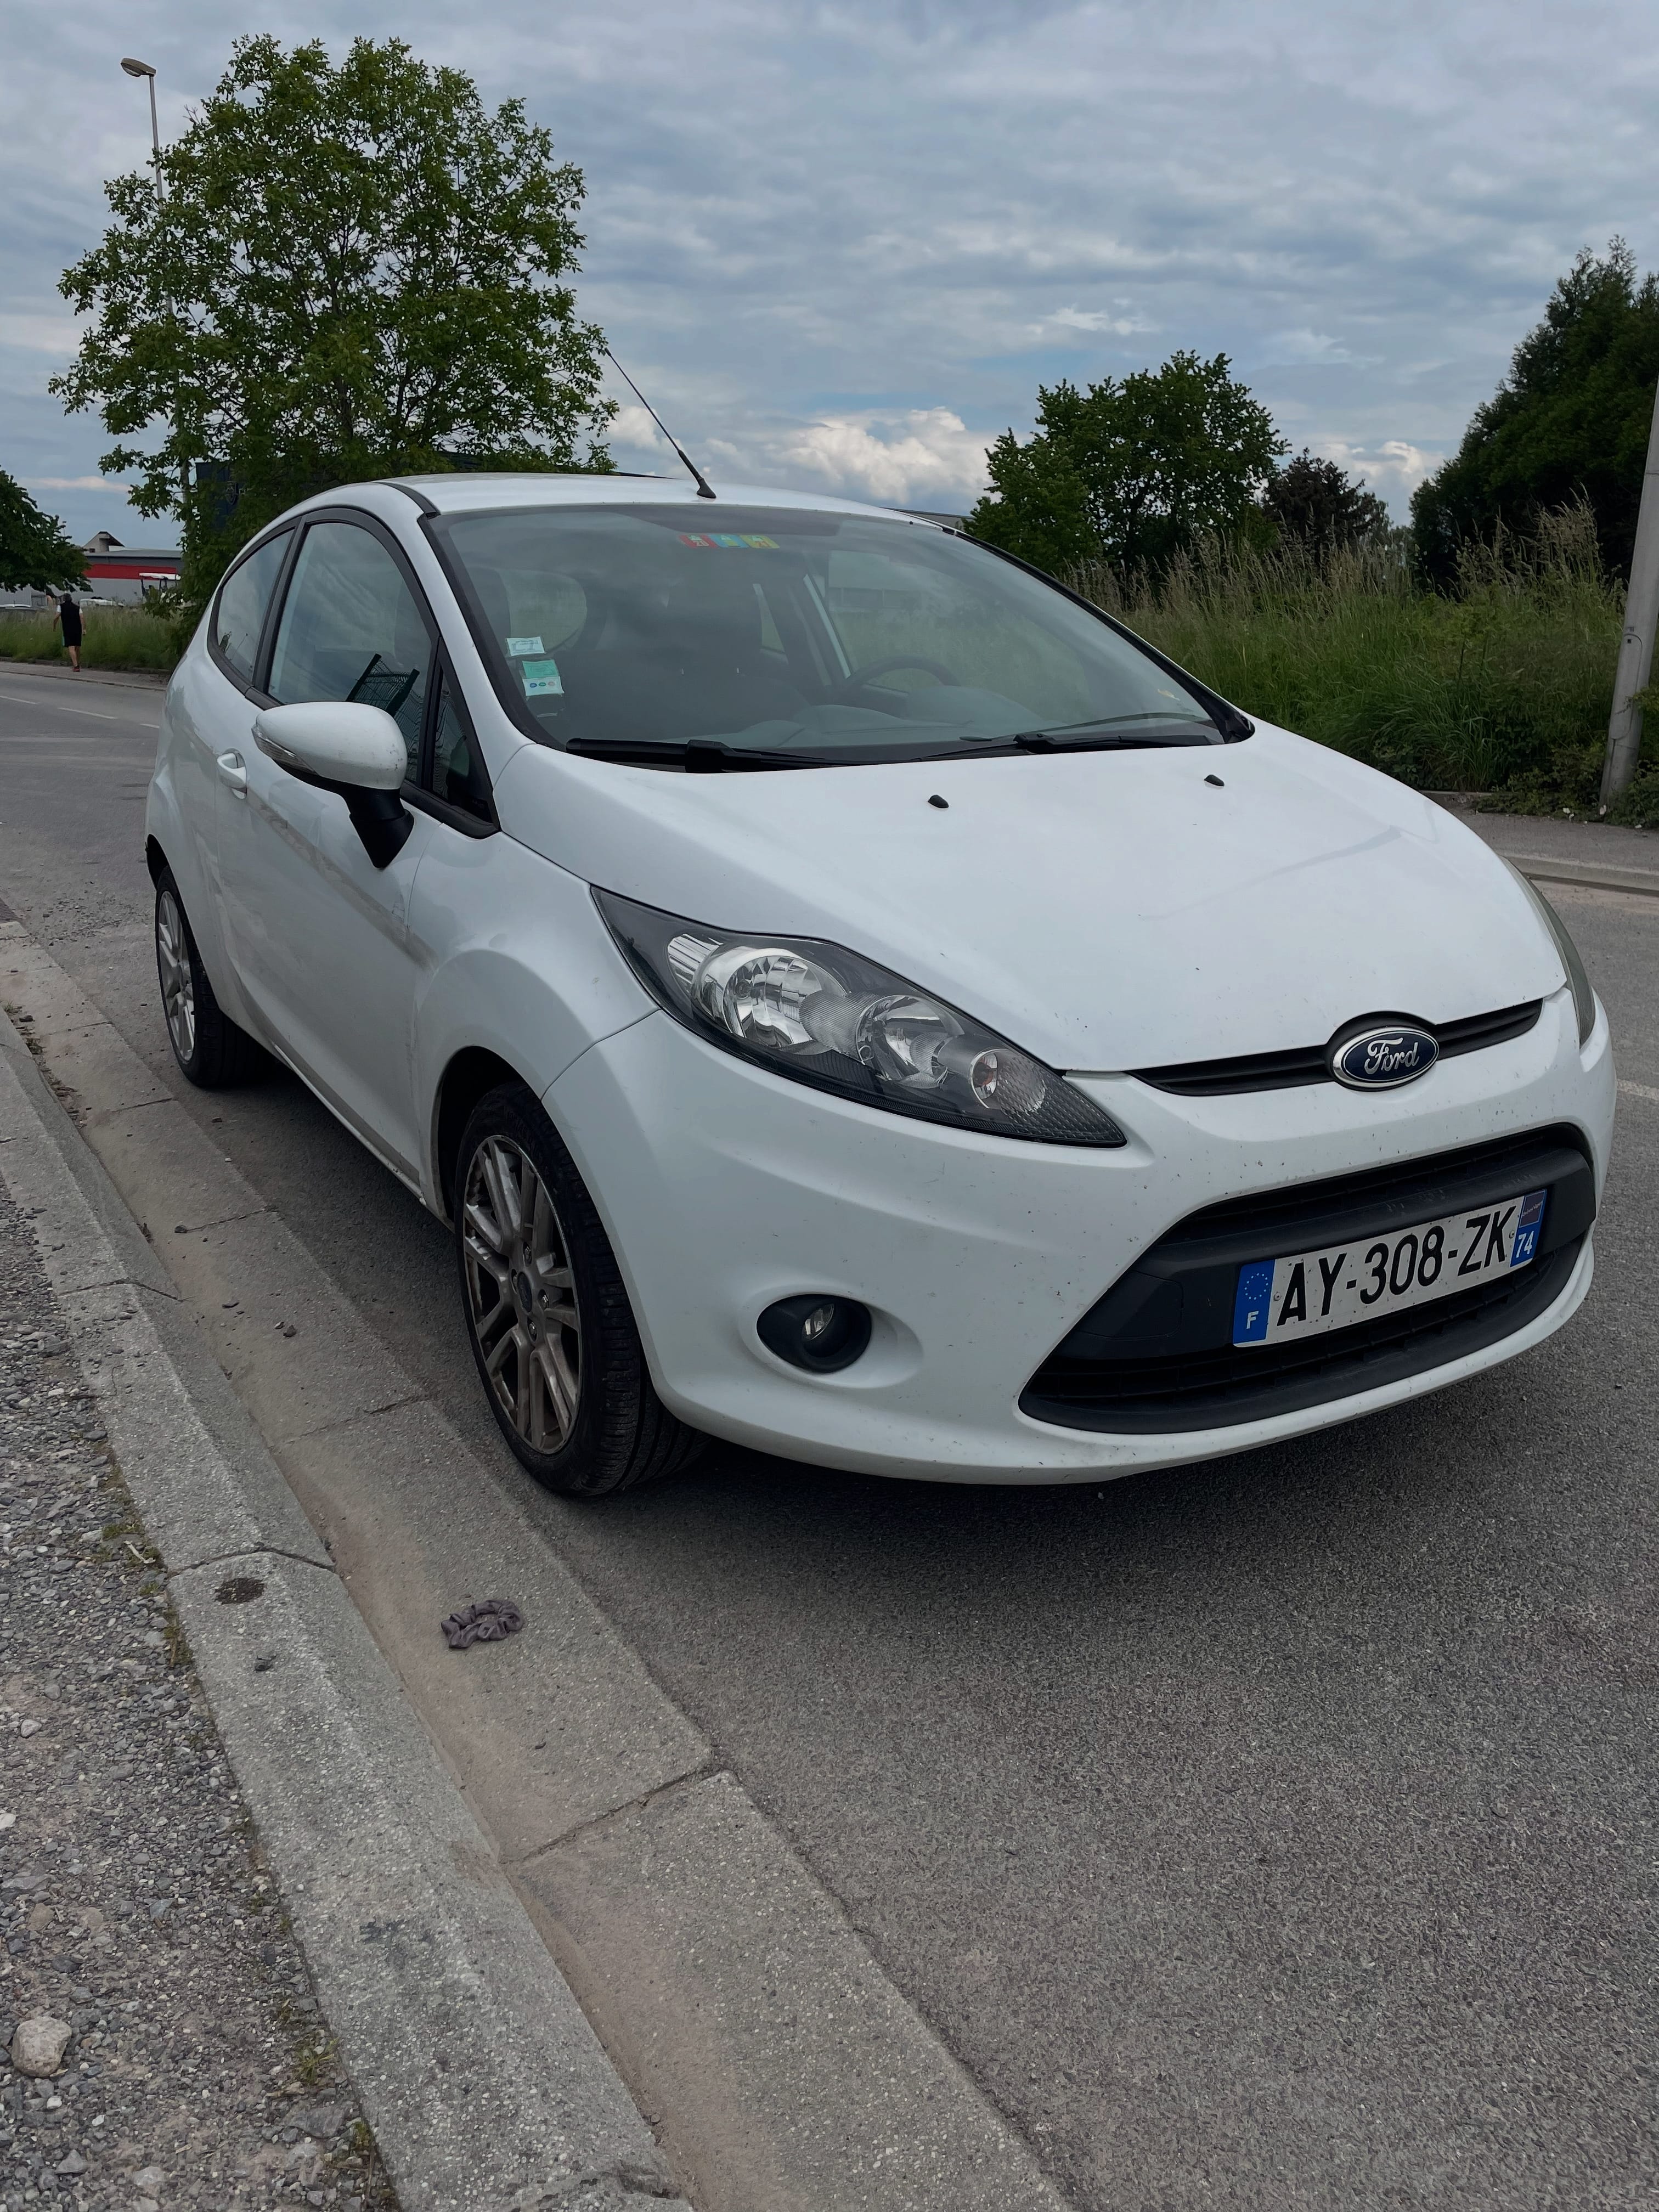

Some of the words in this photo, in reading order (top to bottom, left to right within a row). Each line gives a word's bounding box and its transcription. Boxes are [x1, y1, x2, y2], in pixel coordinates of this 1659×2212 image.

[1364, 1037, 1420, 1075] Ford
[1516, 1231, 1534, 1259] 74
[1277, 1205, 1516, 1327] AY-308-ZK
[1246, 1311, 1259, 1329] F
